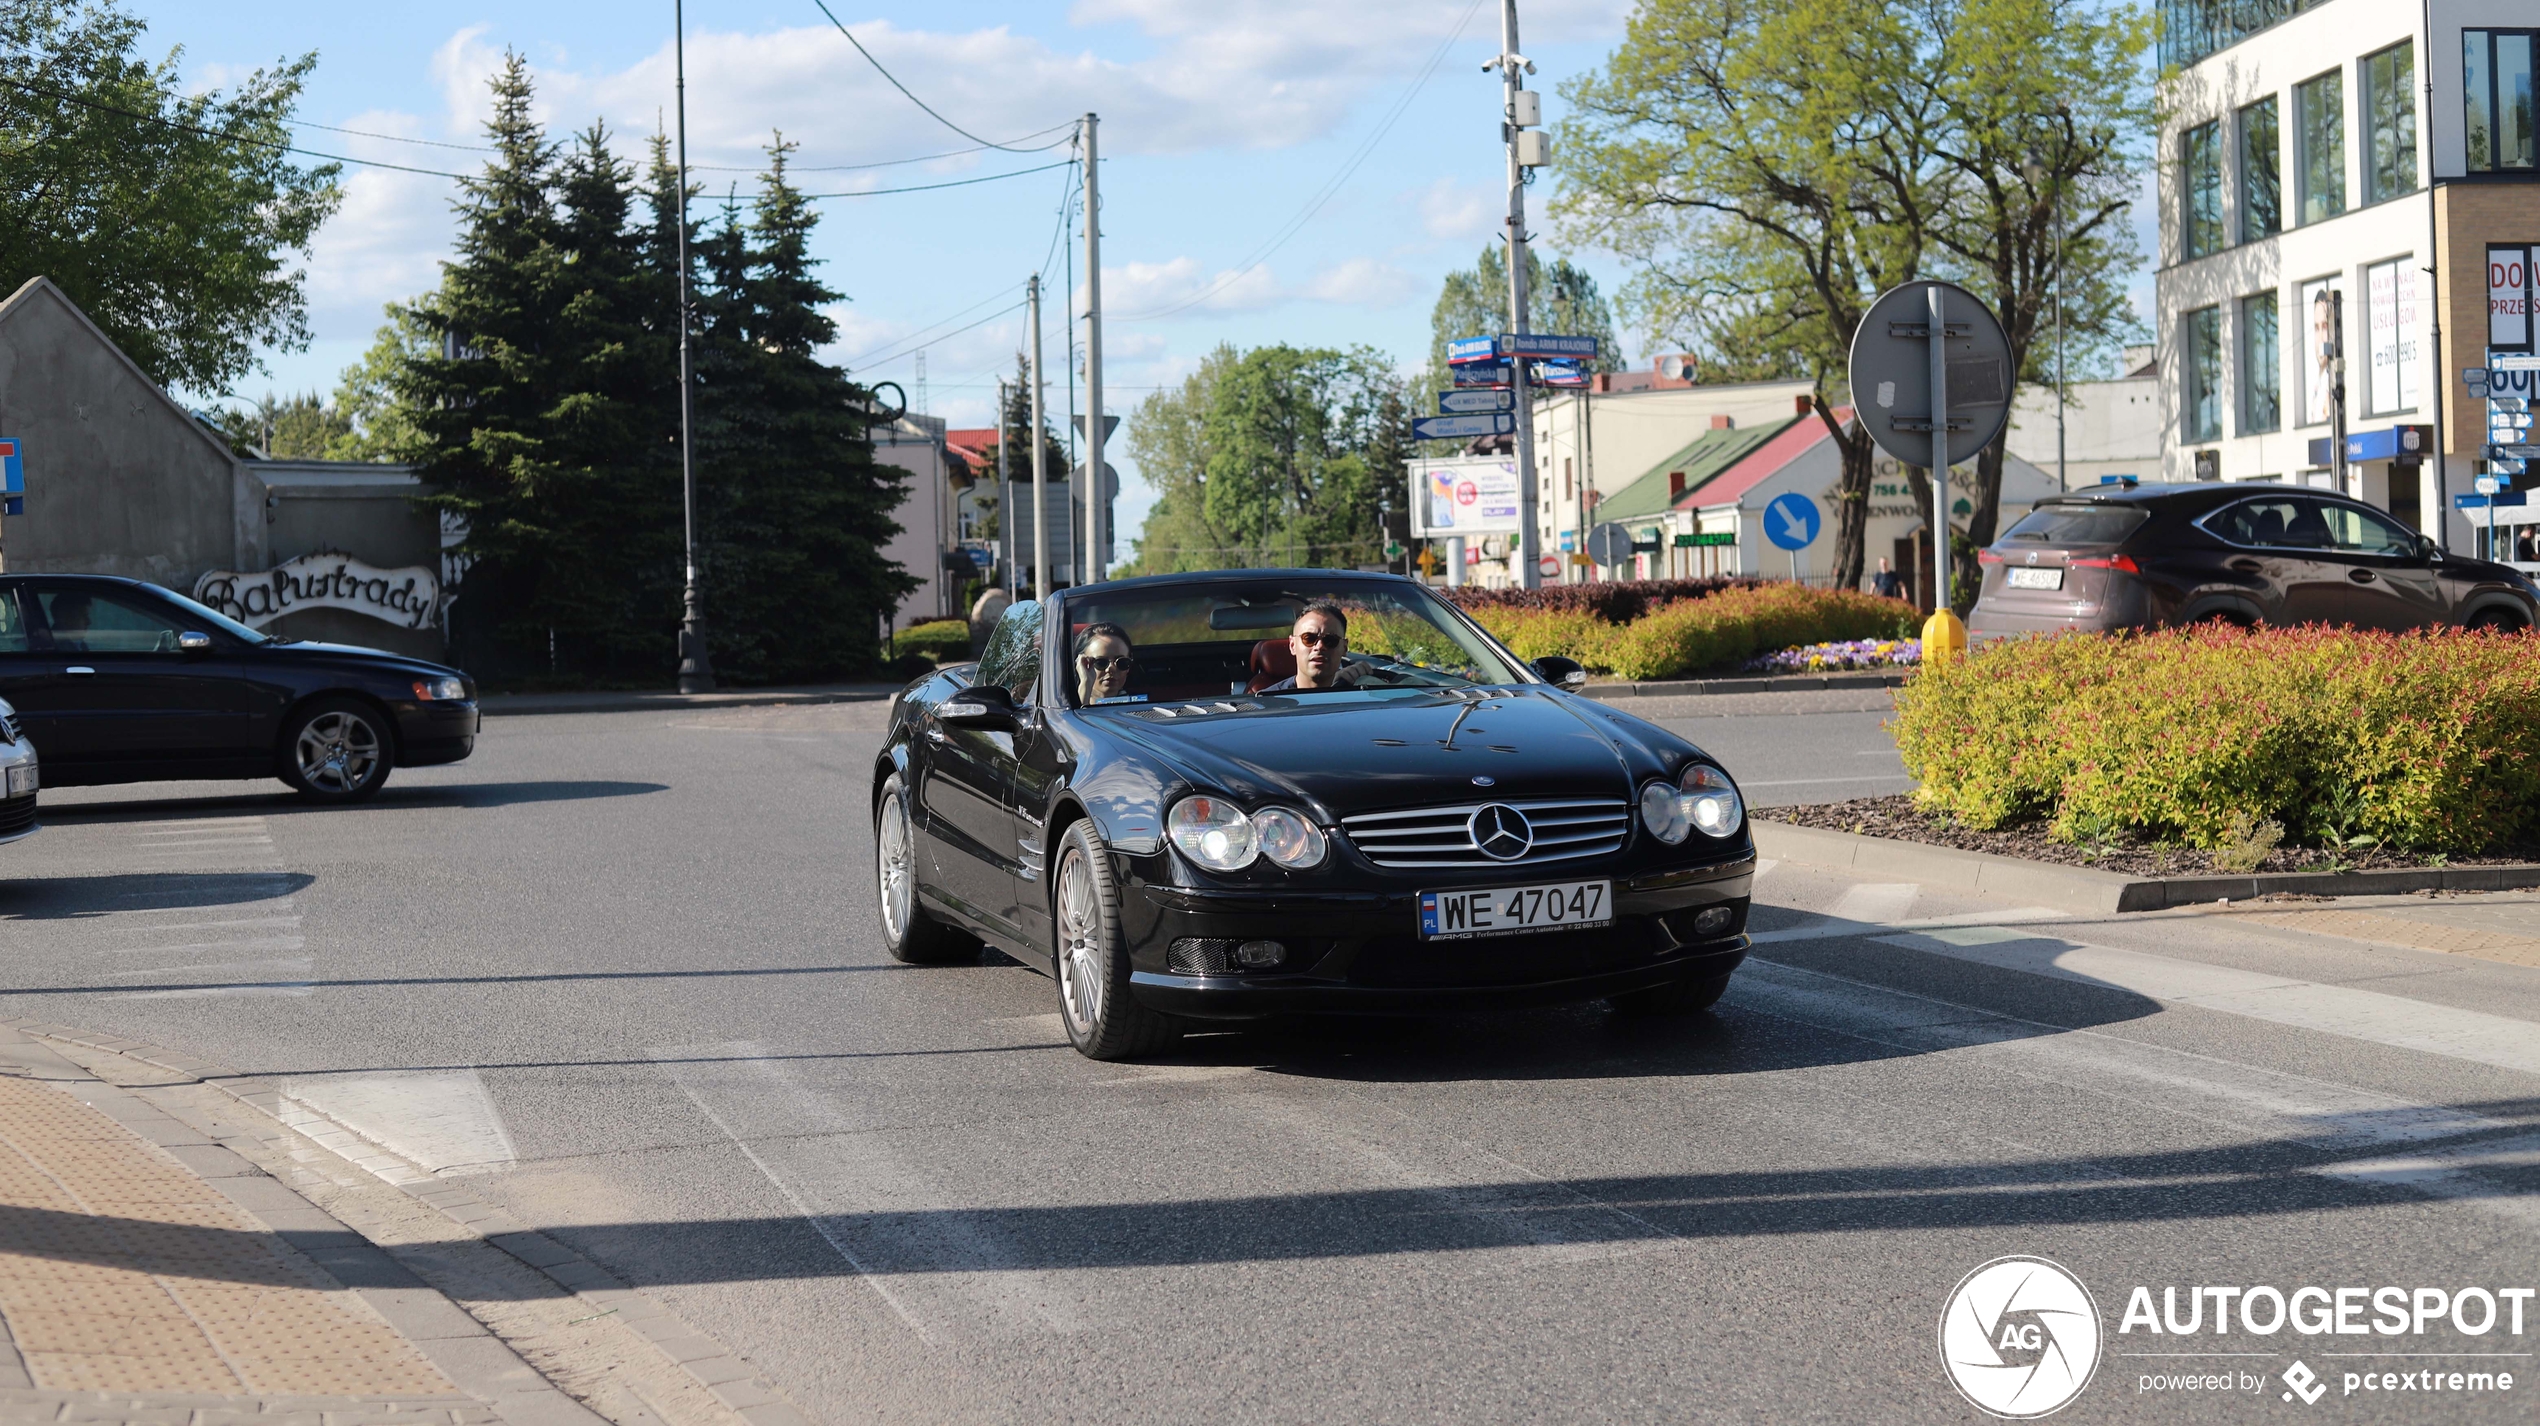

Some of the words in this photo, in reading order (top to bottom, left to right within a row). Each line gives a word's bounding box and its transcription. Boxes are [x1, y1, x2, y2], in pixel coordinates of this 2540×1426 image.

[2490, 262, 2523, 289] DO
[2372, 279, 2382, 291] NA
[1516, 338, 1538, 349] Rondo
[1539, 339, 1558, 350] ARMI
[1559, 340, 1594, 352] KRAJOWEJ
[1874, 484, 1897, 496] 756
[2014, 568, 2028, 582] WE
[201, 564, 430, 628] Balustrady
[1444, 892, 1492, 930] WE
[1506, 883, 1604, 924] 47047
[1424, 919, 1436, 928] PL
[1443, 932, 1473, 940] AMG
[1476, 930, 1514, 938] Performance
[1514, 927, 1534, 935] Center
[1536, 925, 1564, 933] Autotrade
